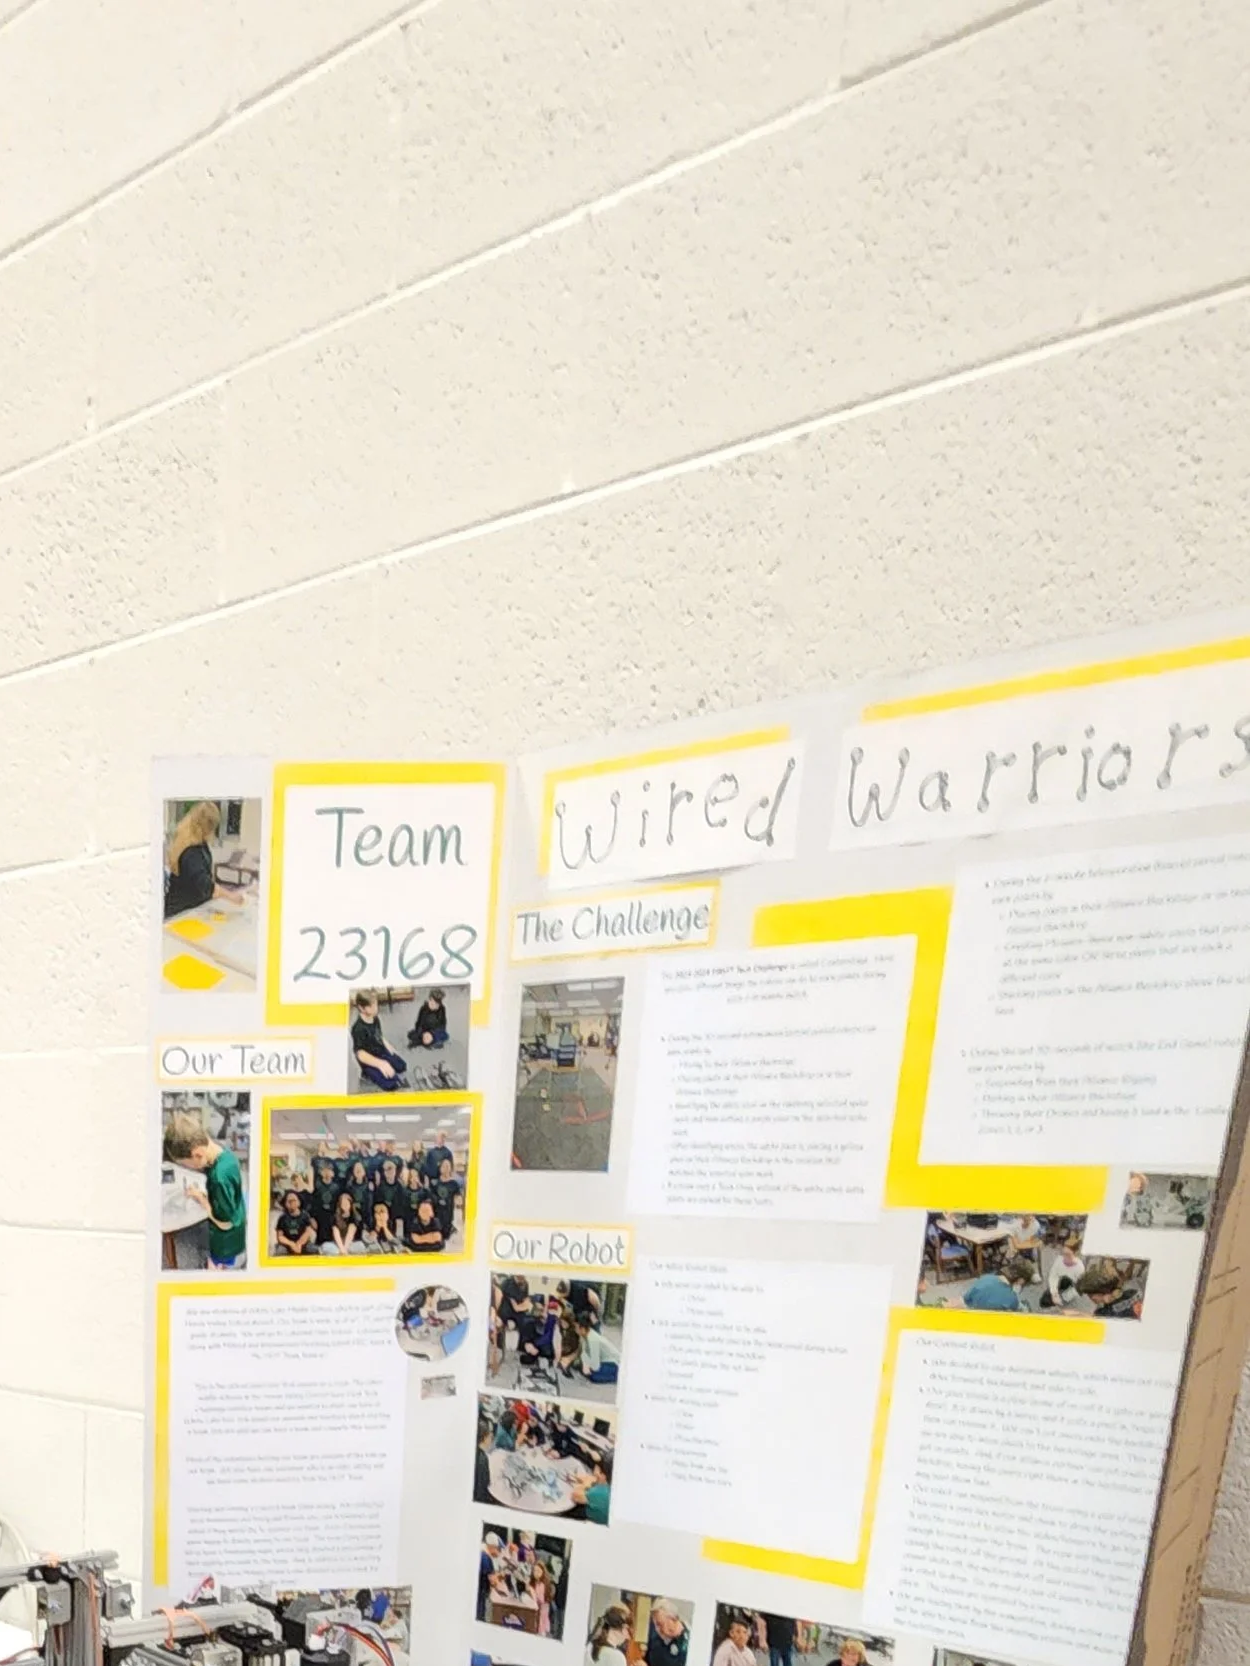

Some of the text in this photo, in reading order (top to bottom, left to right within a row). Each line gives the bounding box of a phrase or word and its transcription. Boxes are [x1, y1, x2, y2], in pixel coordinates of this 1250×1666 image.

[315, 807, 467, 868] Team
[555, 757, 796, 870] Wired
[516, 900, 710, 945] The Challenge
[293, 924, 478, 982] 23168
[162, 1044, 307, 1076] Our Team
[493, 1230, 626, 1266] Our Robot
